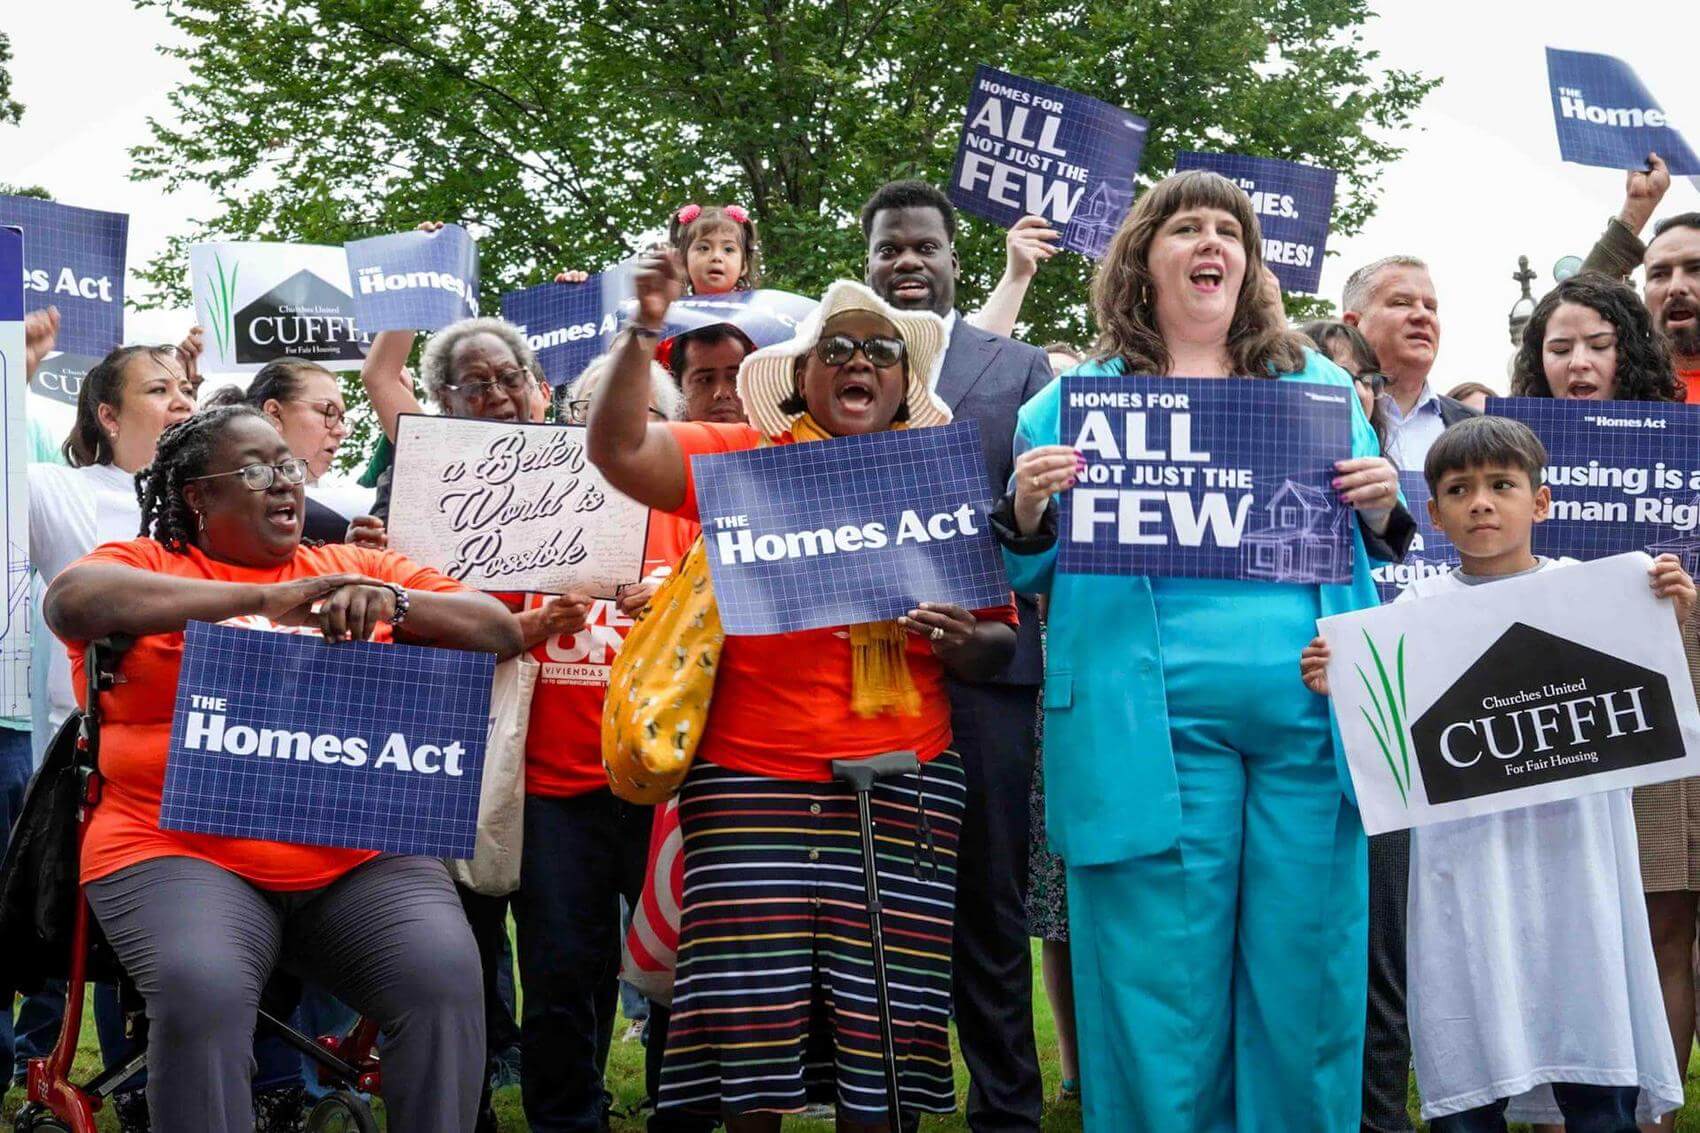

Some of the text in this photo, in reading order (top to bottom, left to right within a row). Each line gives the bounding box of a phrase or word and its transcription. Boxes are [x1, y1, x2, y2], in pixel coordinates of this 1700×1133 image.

[979, 79, 1064, 114] HOMES FOR
[970, 97, 1067, 158] ALL
[966, 133, 1089, 184] NOT JUST THE
[959, 150, 1086, 225] FEW
[1248, 191, 1299, 219] MES.
[54, 267, 113, 302] Act
[1070, 392, 1189, 409] HOMES FOR
[1074, 410, 1211, 463] ALL
[1596, 415, 1642, 428] Homes
[1643, 417, 1667, 429] Act
[440, 461, 467, 483] a
[475, 429, 587, 486] Better
[1132, 465, 1196, 487] JUST
[1202, 467, 1254, 490] THE
[1541, 460, 1648, 495] using
[1655, 462, 1684, 490] is
[439, 478, 605, 532] World is
[714, 513, 749, 529] THE
[1071, 488, 1254, 548] FEW
[1547, 497, 1700, 531] man Rig
[716, 502, 979, 566] Homes Act
[443, 526, 588, 581] Possible
[545, 666, 604, 678] VIVIENDAS
[190, 694, 228, 712] THE
[1482, 678, 1587, 710] Churches United
[184, 711, 466, 776] Homes Act
[1439, 686, 1654, 768] CUFFH
[1504, 750, 1600, 776] For Fair Housing
